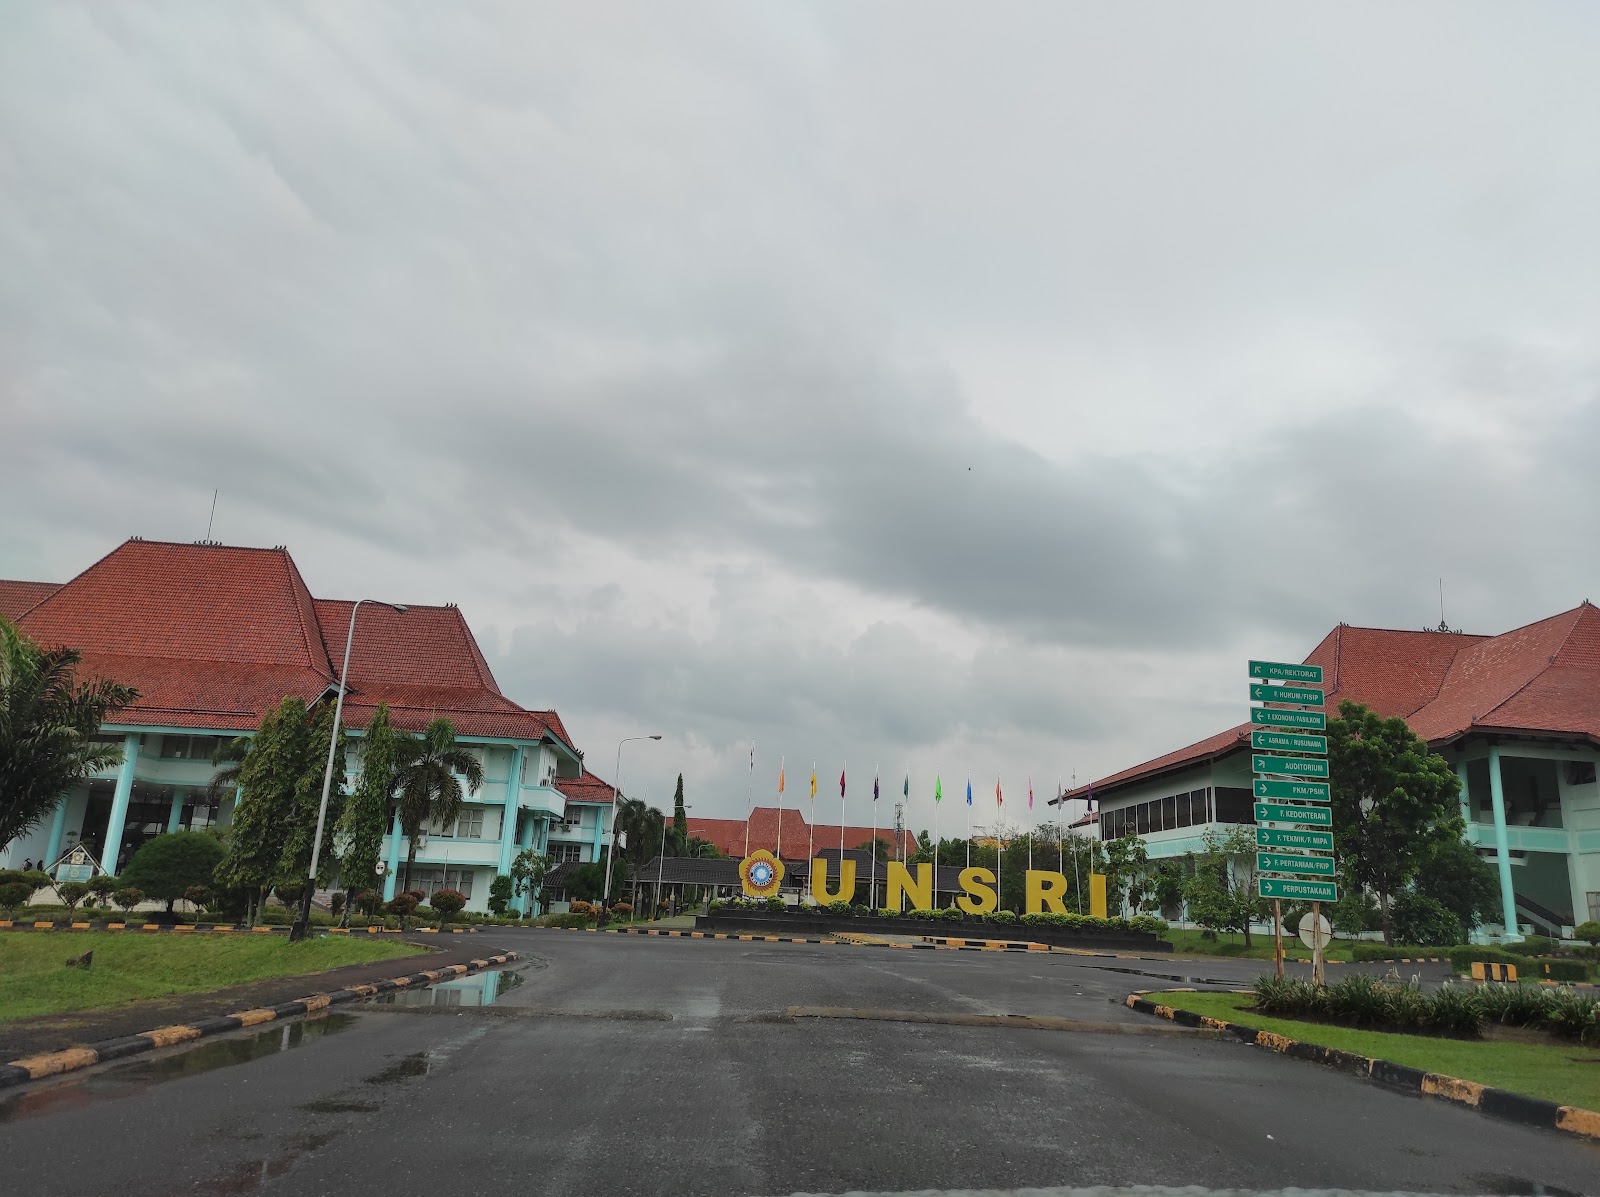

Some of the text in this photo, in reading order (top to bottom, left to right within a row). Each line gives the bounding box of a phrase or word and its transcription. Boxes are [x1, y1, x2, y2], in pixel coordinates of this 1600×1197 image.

[1269, 668, 1317, 678] KPA/REKTORAT
[1279, 692, 1319, 701] HUKUM/FISIP
[1285, 762, 1323, 772] AUDITORIUM
[1292, 787, 1325, 795] FKM/PSIK
[1280, 809, 1326, 820] F. KEDOKTERAN
[1277, 834, 1282, 842] F.
[1280, 860, 1330, 870] PERTANIAN/FKIP
[812, 858, 1107, 919] UNSRI
[1283, 885, 1332, 895] PERPUSTAKAAN
